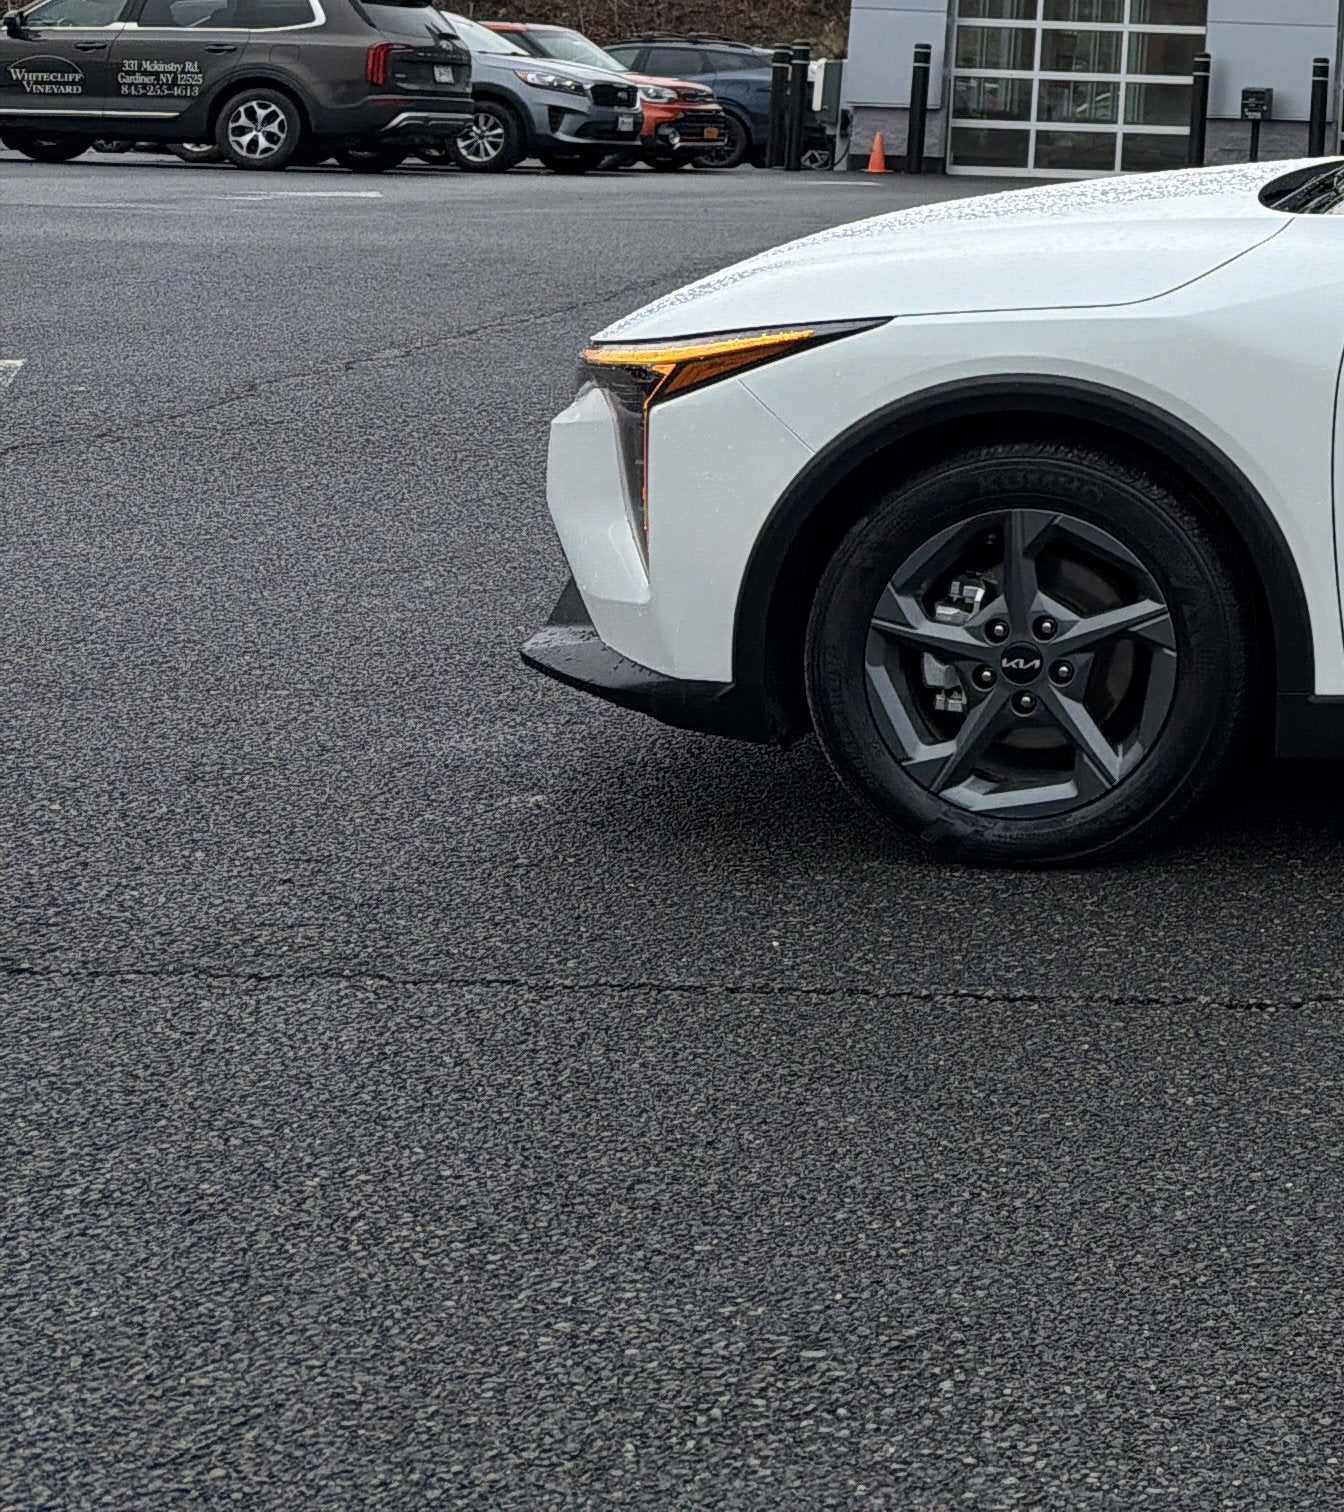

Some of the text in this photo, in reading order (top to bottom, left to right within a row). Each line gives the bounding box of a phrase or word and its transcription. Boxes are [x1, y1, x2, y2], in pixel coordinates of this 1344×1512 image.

[122, 59, 138, 71] 331
[185, 61, 200, 73] Rd.
[10, 68, 83, 82] WHITECLIFF
[159, 73, 175, 84] NY
[177, 73, 203, 85] 12525
[22, 80, 82, 94] VINEYARD
[1001, 657, 1041, 669] KIA
